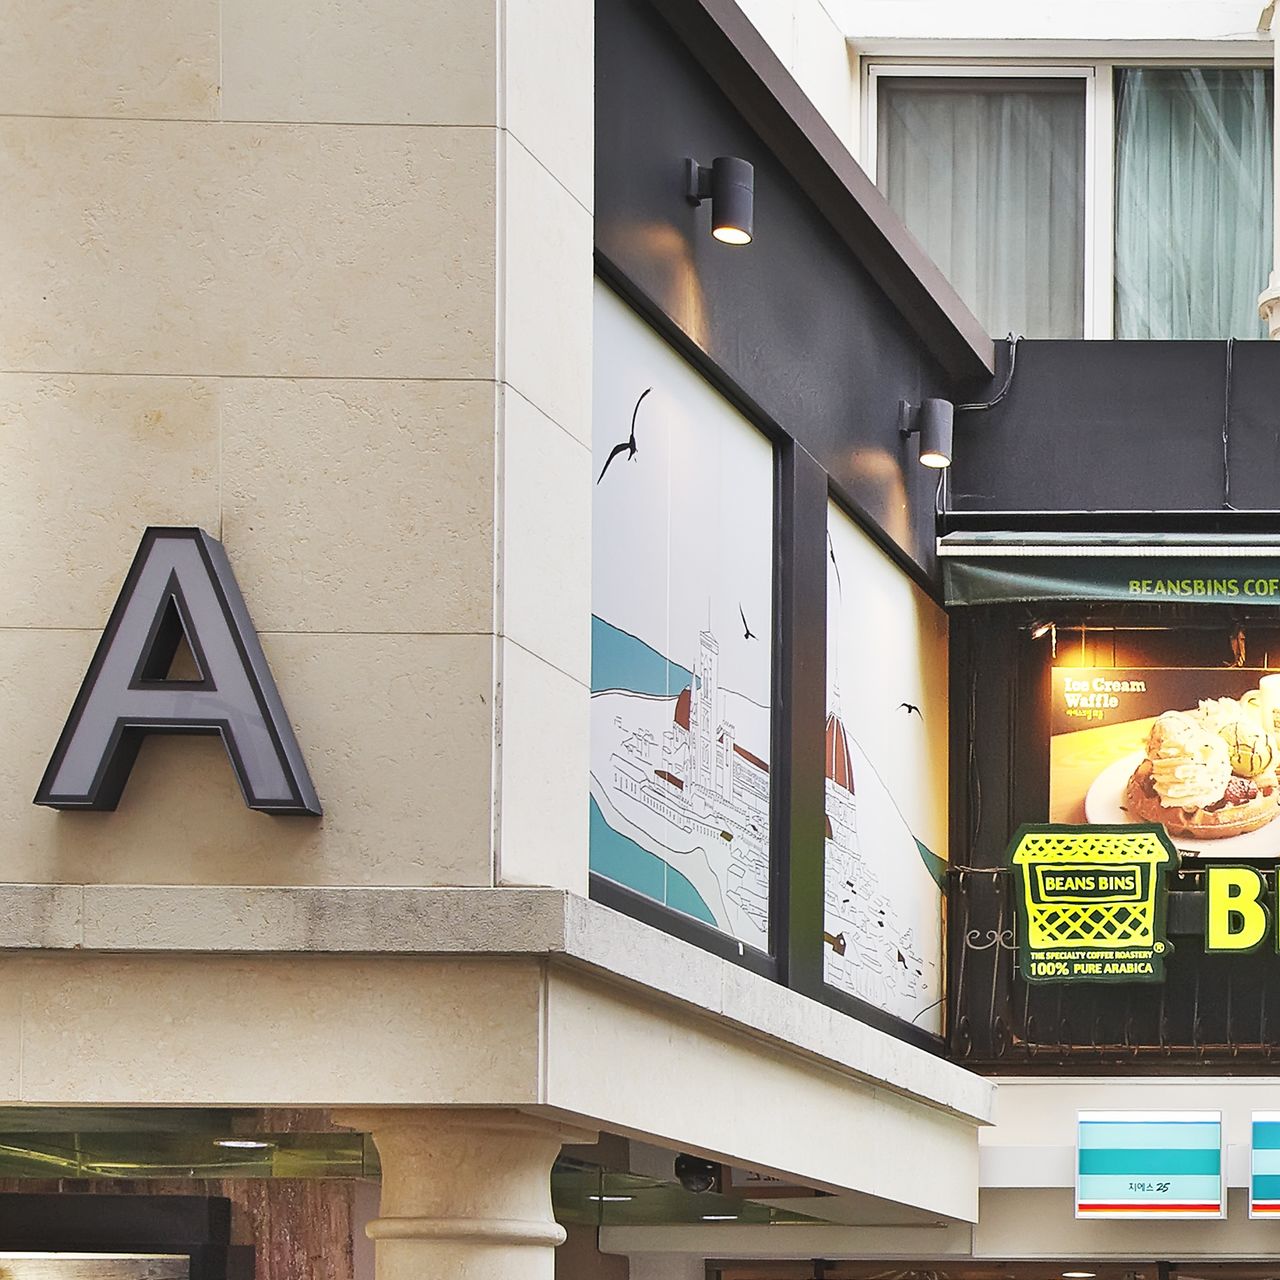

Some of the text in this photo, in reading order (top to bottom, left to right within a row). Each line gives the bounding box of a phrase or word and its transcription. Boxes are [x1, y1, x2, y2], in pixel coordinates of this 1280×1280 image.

[1129, 579, 1239, 596] BEANSBINS
[34, 527, 322, 816] A
[1093, 677, 1146, 693] Cream
[1064, 693, 1119, 708] Waffle
[1045, 877, 1135, 890] BEANS BINS
[1046, 952, 1086, 960] SPECIALTY
[1087, 952, 1114, 960] COFFEE
[1115, 952, 1153, 960] ROASTERY
[1031, 963, 1153, 975] 100% PURE ARABICA
[1128, 1182, 1171, 1193] 지에스 25
